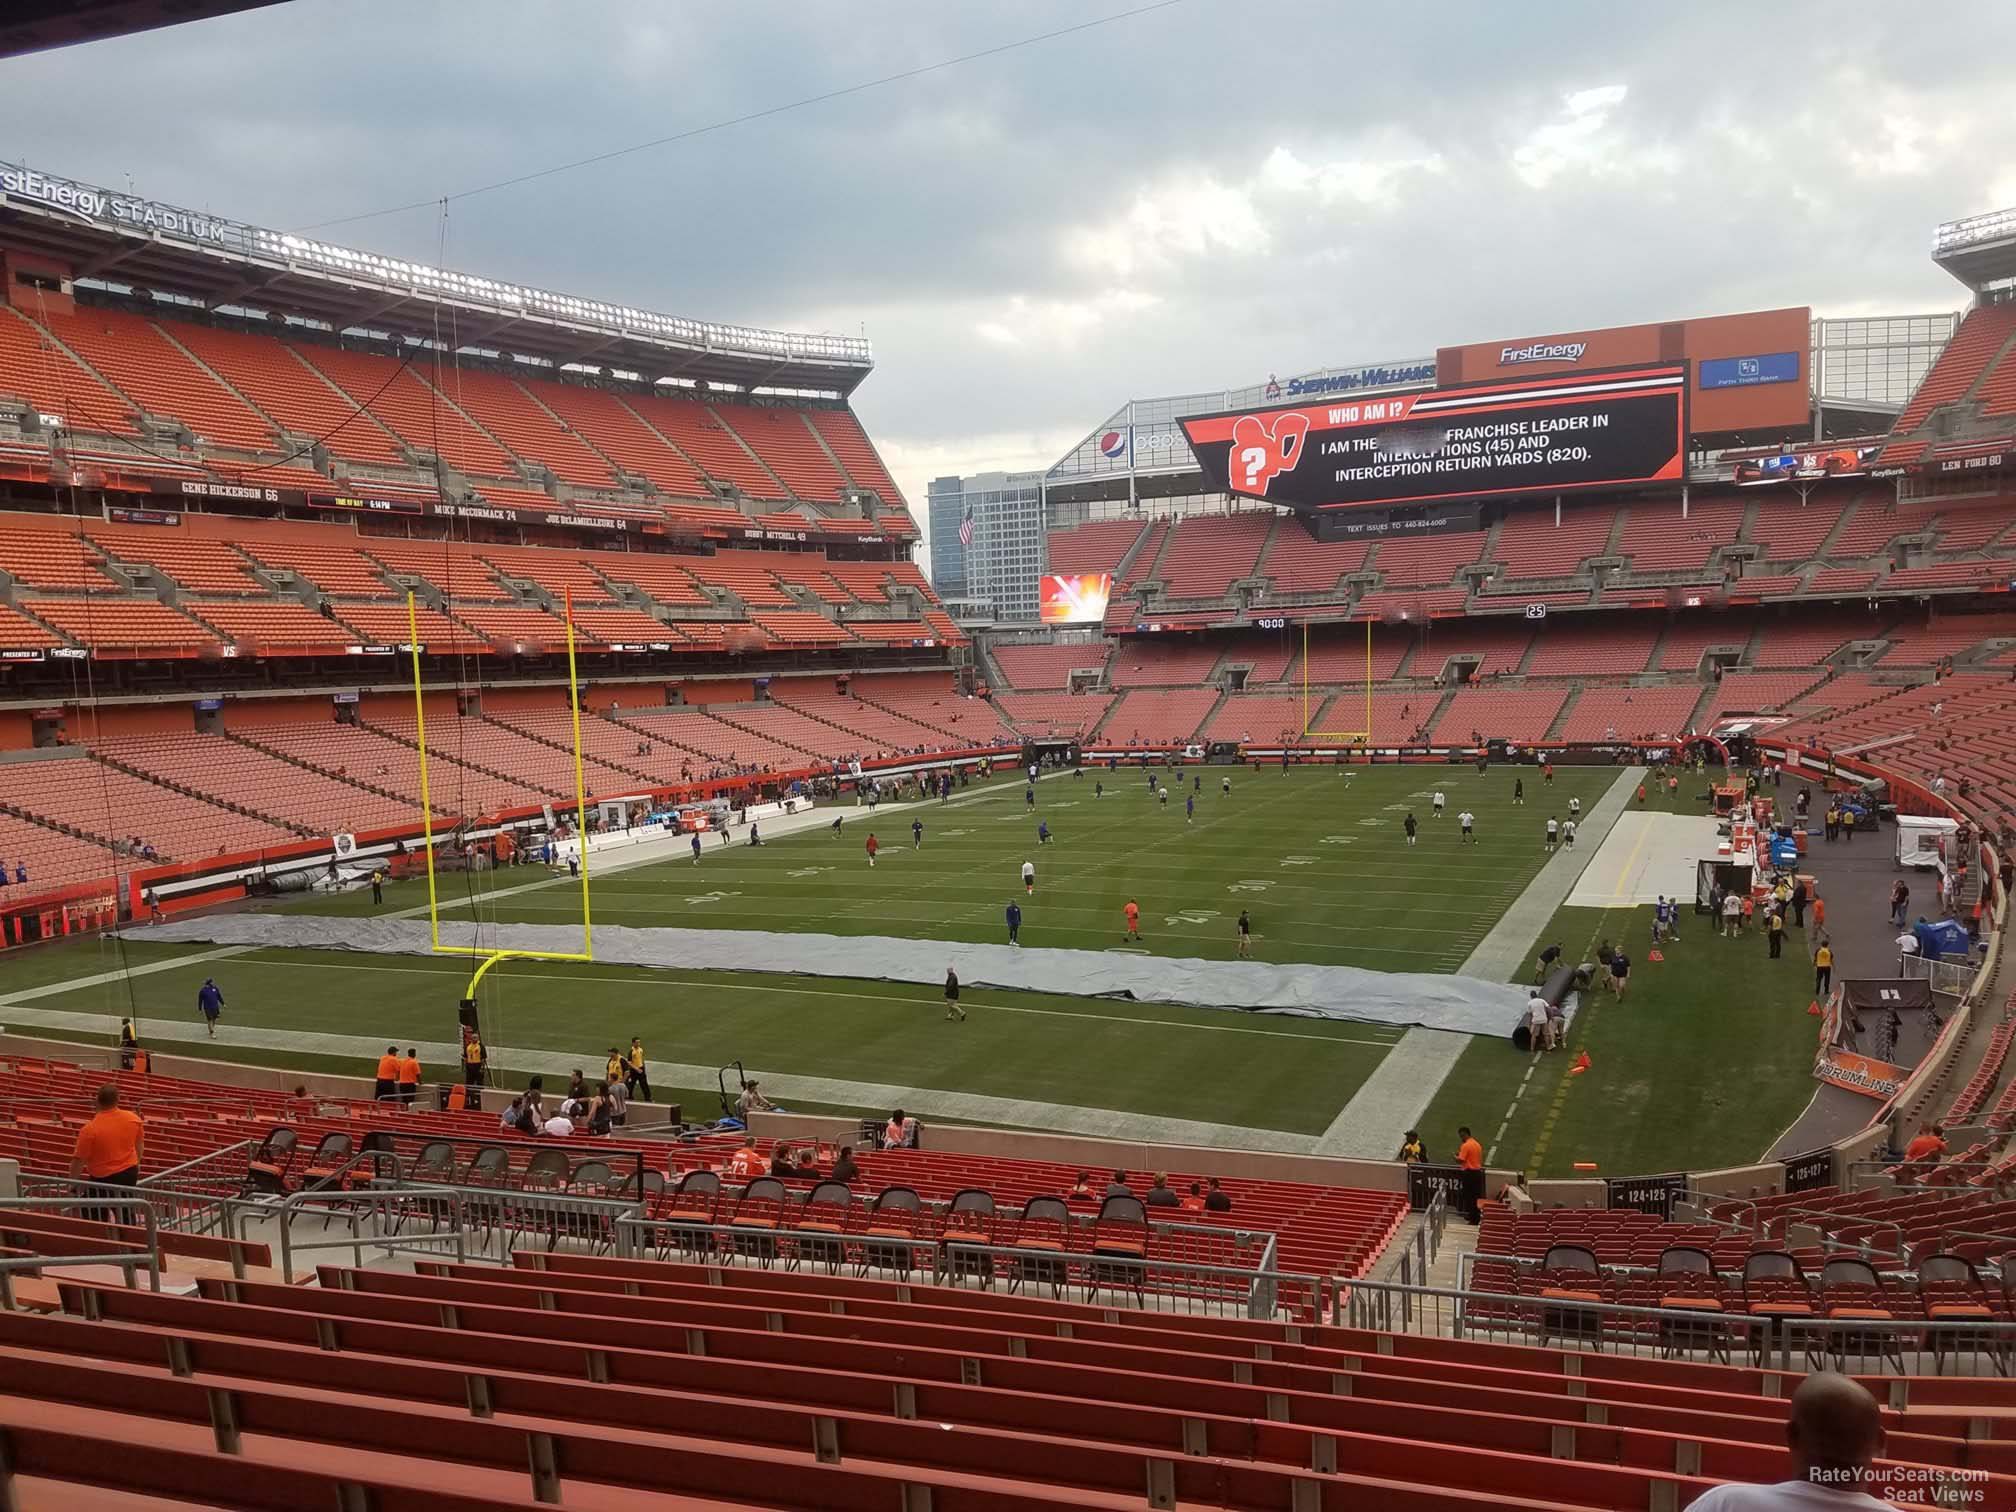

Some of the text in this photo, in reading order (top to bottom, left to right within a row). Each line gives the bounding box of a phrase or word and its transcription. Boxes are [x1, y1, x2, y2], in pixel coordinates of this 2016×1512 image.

[111, 200, 225, 241] STADIUM
[1501, 342, 1586, 363] FirstEnergy
[1328, 401, 1404, 424] WHO AM I?
[1321, 414, 1609, 455] I AM THE FRANCHISE LEADER IN
[1485, 439, 1515, 453] (45)
[1518, 434, 1550, 449] AND
[1335, 444, 1592, 482] INTERCEPTION RETURN YARDS (820).
[1942, 461, 1960, 471] LEN
[1964, 458, 1988, 469] FORD
[181, 481, 279, 501] GENE HICKERSON 66
[382, 501, 391, 509] PM
[434, 504, 455, 515] MIKE
[506, 510, 517, 520] 74
[1347, 525, 1363, 533] TEXT
[1366, 523, 1388, 531] ISSUES
[1529, 607, 1543, 616] 25
[223, 646, 235, 656] VS
[1822, 1064, 1897, 1098] DRUMLINE
